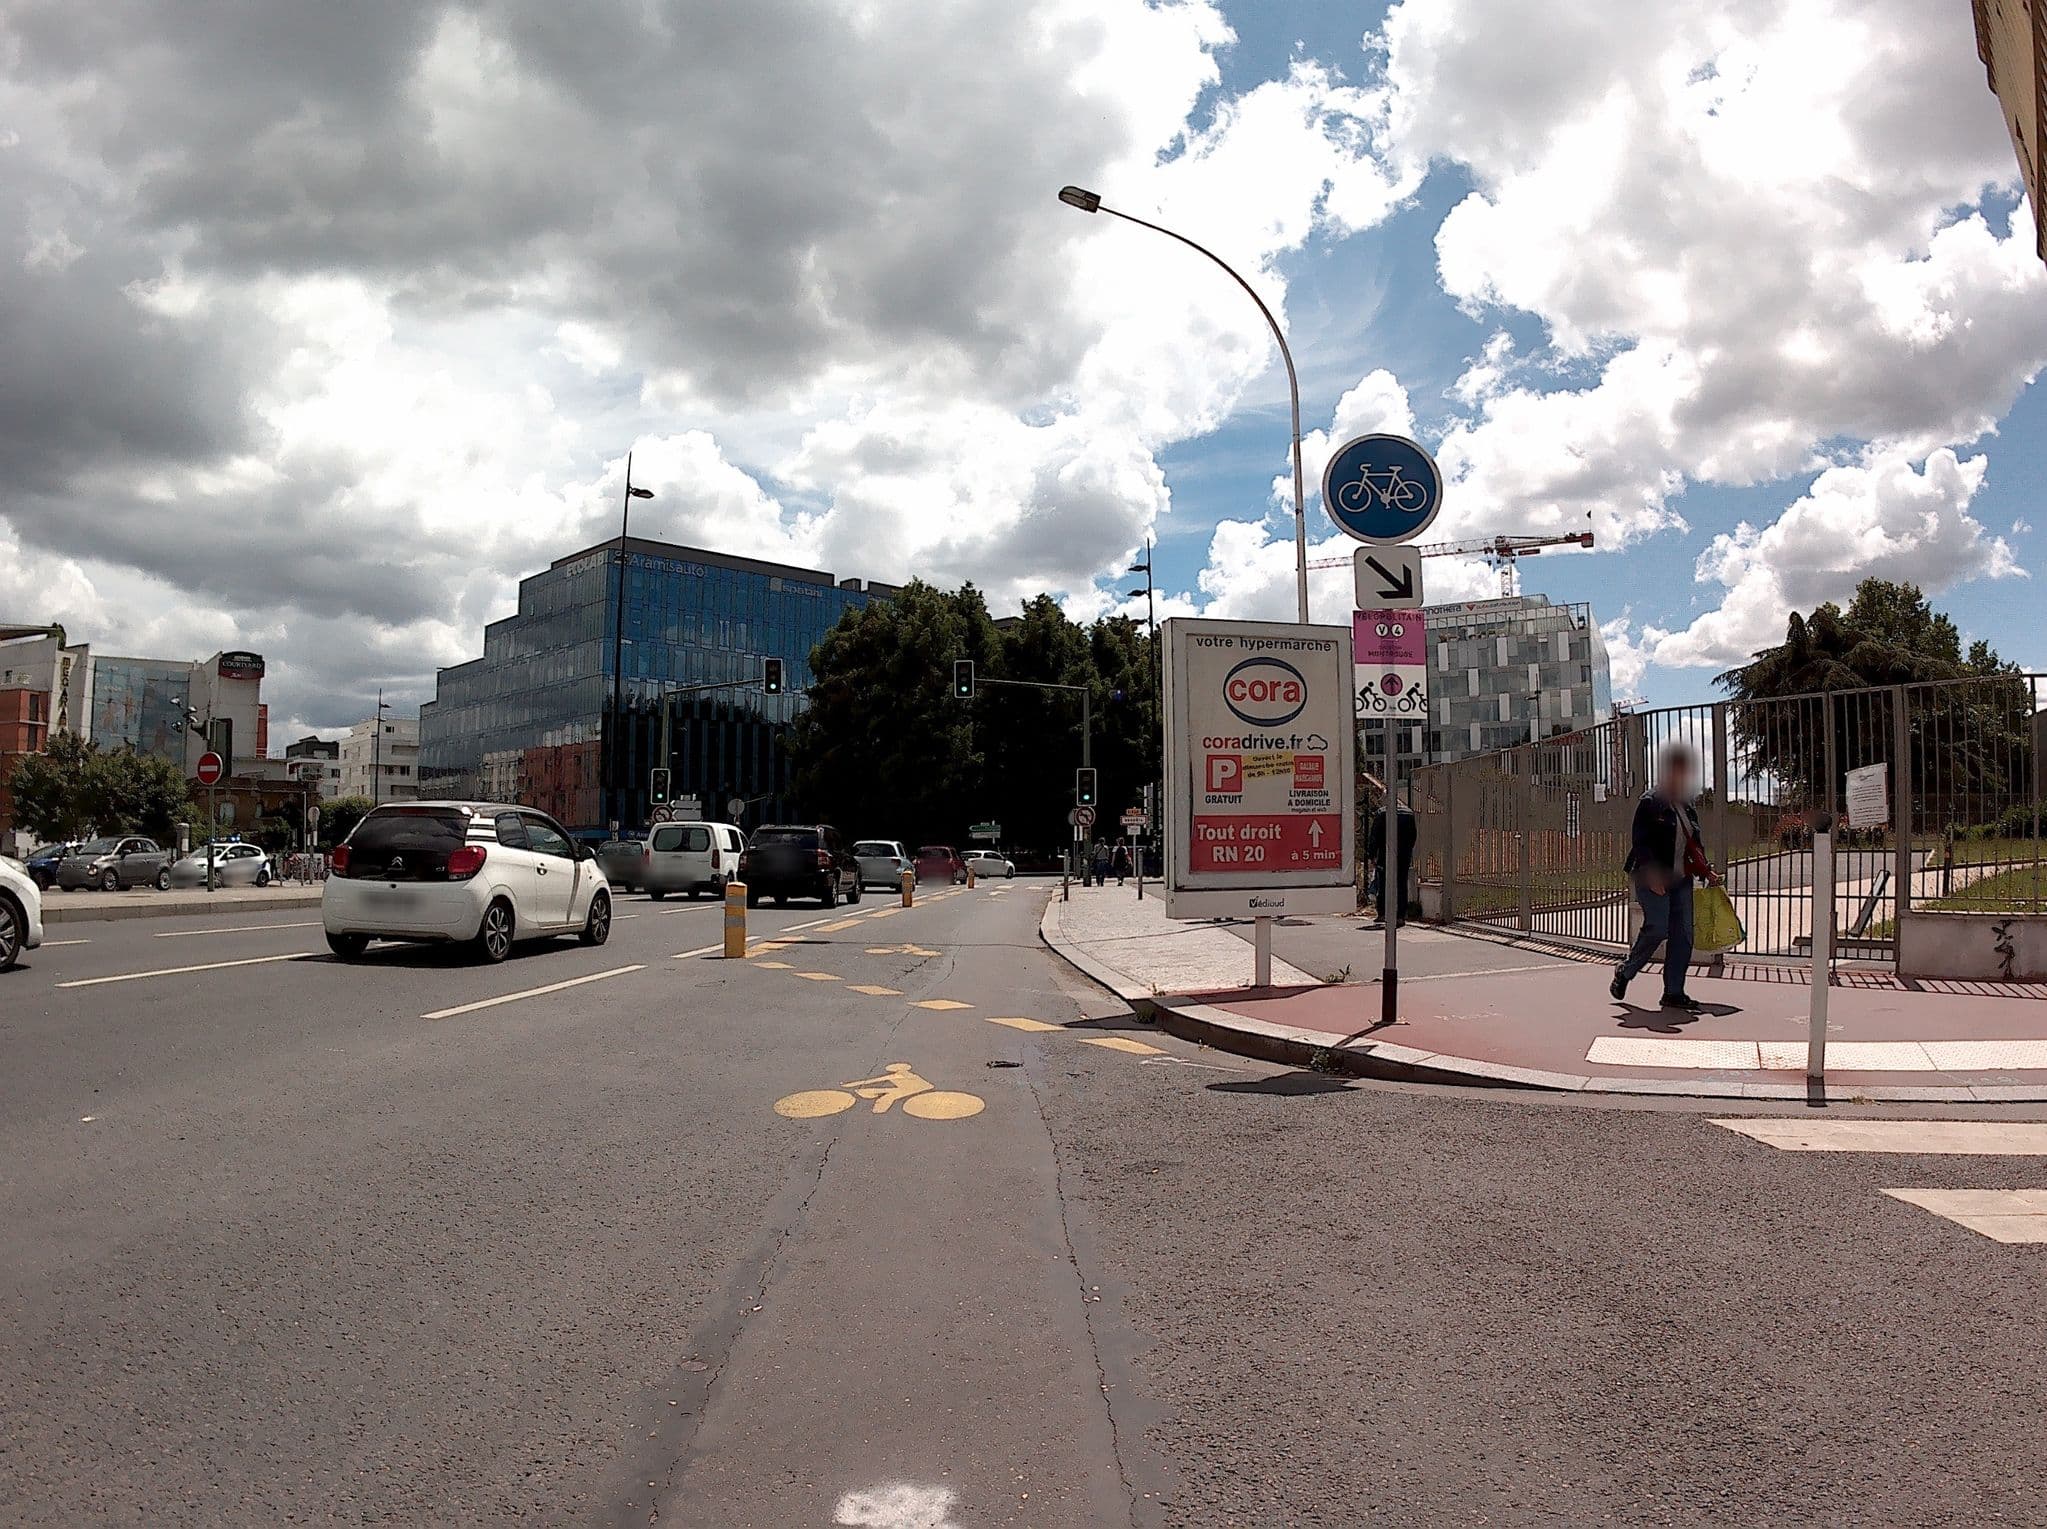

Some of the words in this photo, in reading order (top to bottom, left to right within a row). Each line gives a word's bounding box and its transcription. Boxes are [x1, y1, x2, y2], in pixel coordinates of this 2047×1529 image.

[1378, 626, 1386, 635] V
[1394, 626, 1401, 635] 4
[1196, 636, 1234, 648] votre
[1228, 679, 1301, 702] cora
[1202, 734, 1303, 750] coradrive.fr
[1289, 789, 1329, 797] LIVRAISON
[1205, 794, 1243, 804] GRATUIT
[1295, 798, 1331, 807] DOMICILE
[1197, 824, 1235, 841] Tout
[1240, 823, 1282, 840] droit
[1212, 846, 1239, 862] RN
[1244, 845, 1265, 862] 20
[1291, 850, 1299, 860] à
[1303, 851, 1309, 860] 5
[1313, 850, 1336, 860] min
